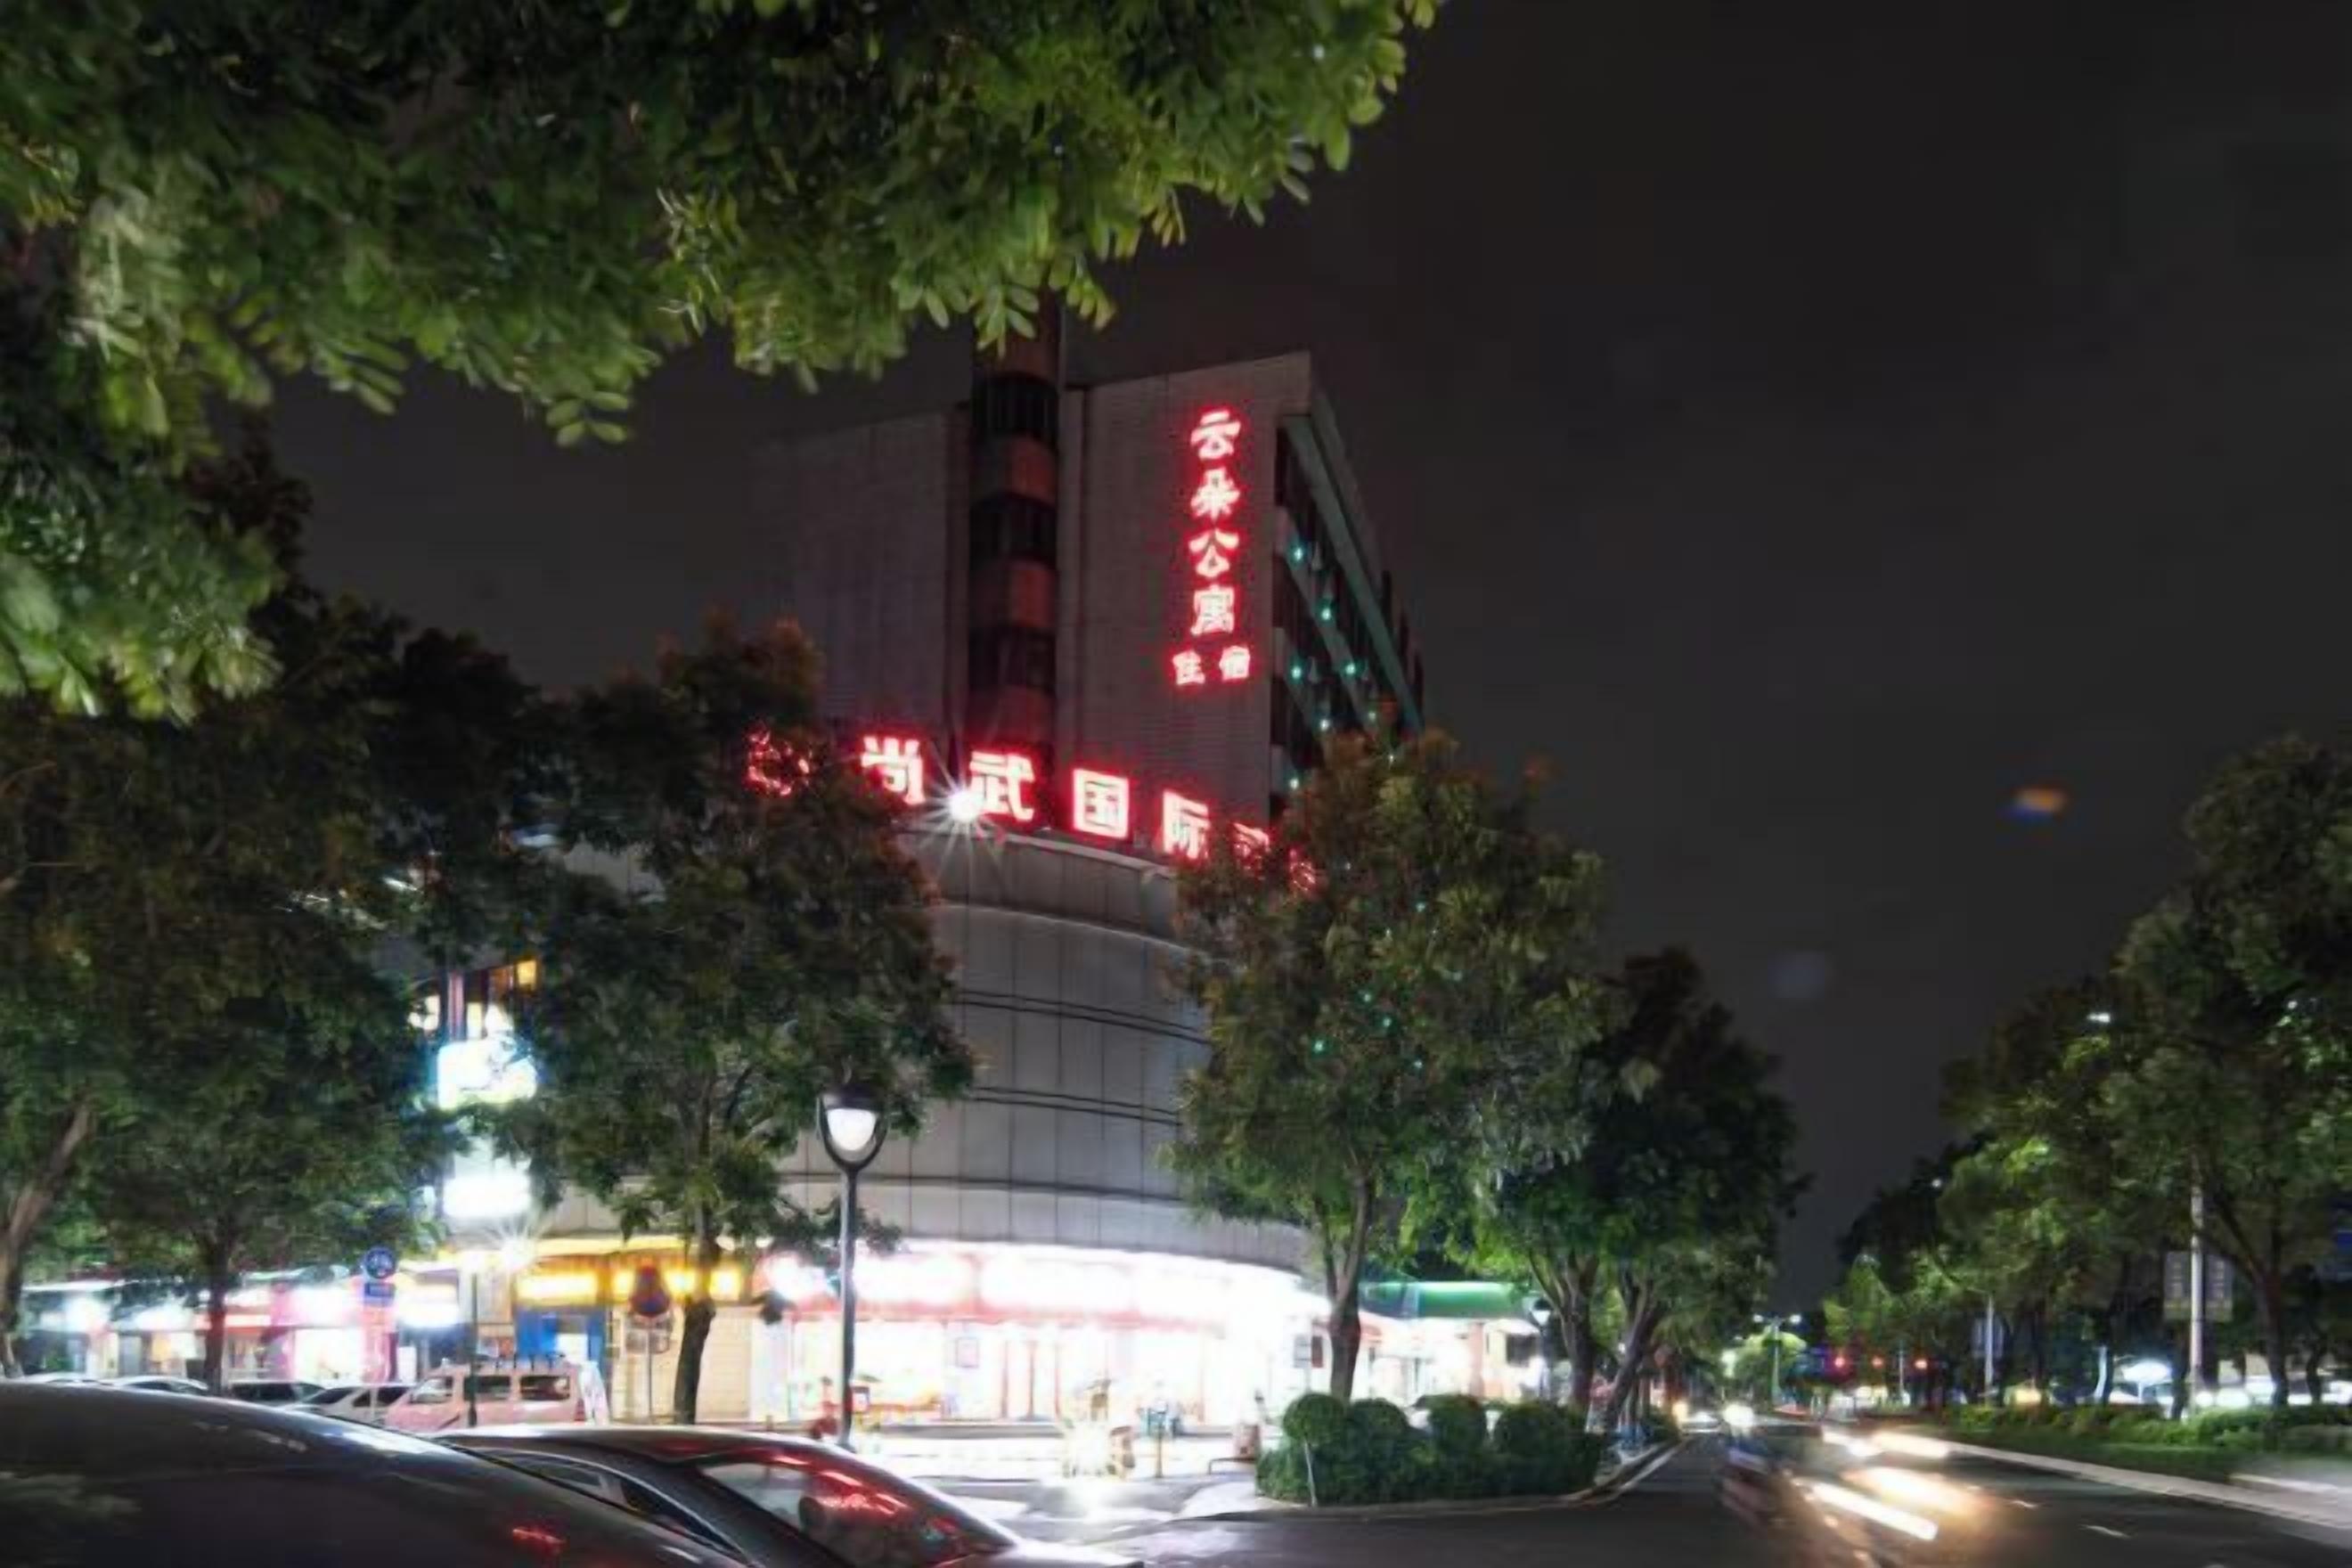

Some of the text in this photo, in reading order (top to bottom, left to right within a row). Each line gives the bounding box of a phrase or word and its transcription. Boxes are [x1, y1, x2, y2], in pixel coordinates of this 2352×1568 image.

[1189, 409, 1241, 635] 云朵公寓
[861, 735, 1316, 893] 尚武国际
